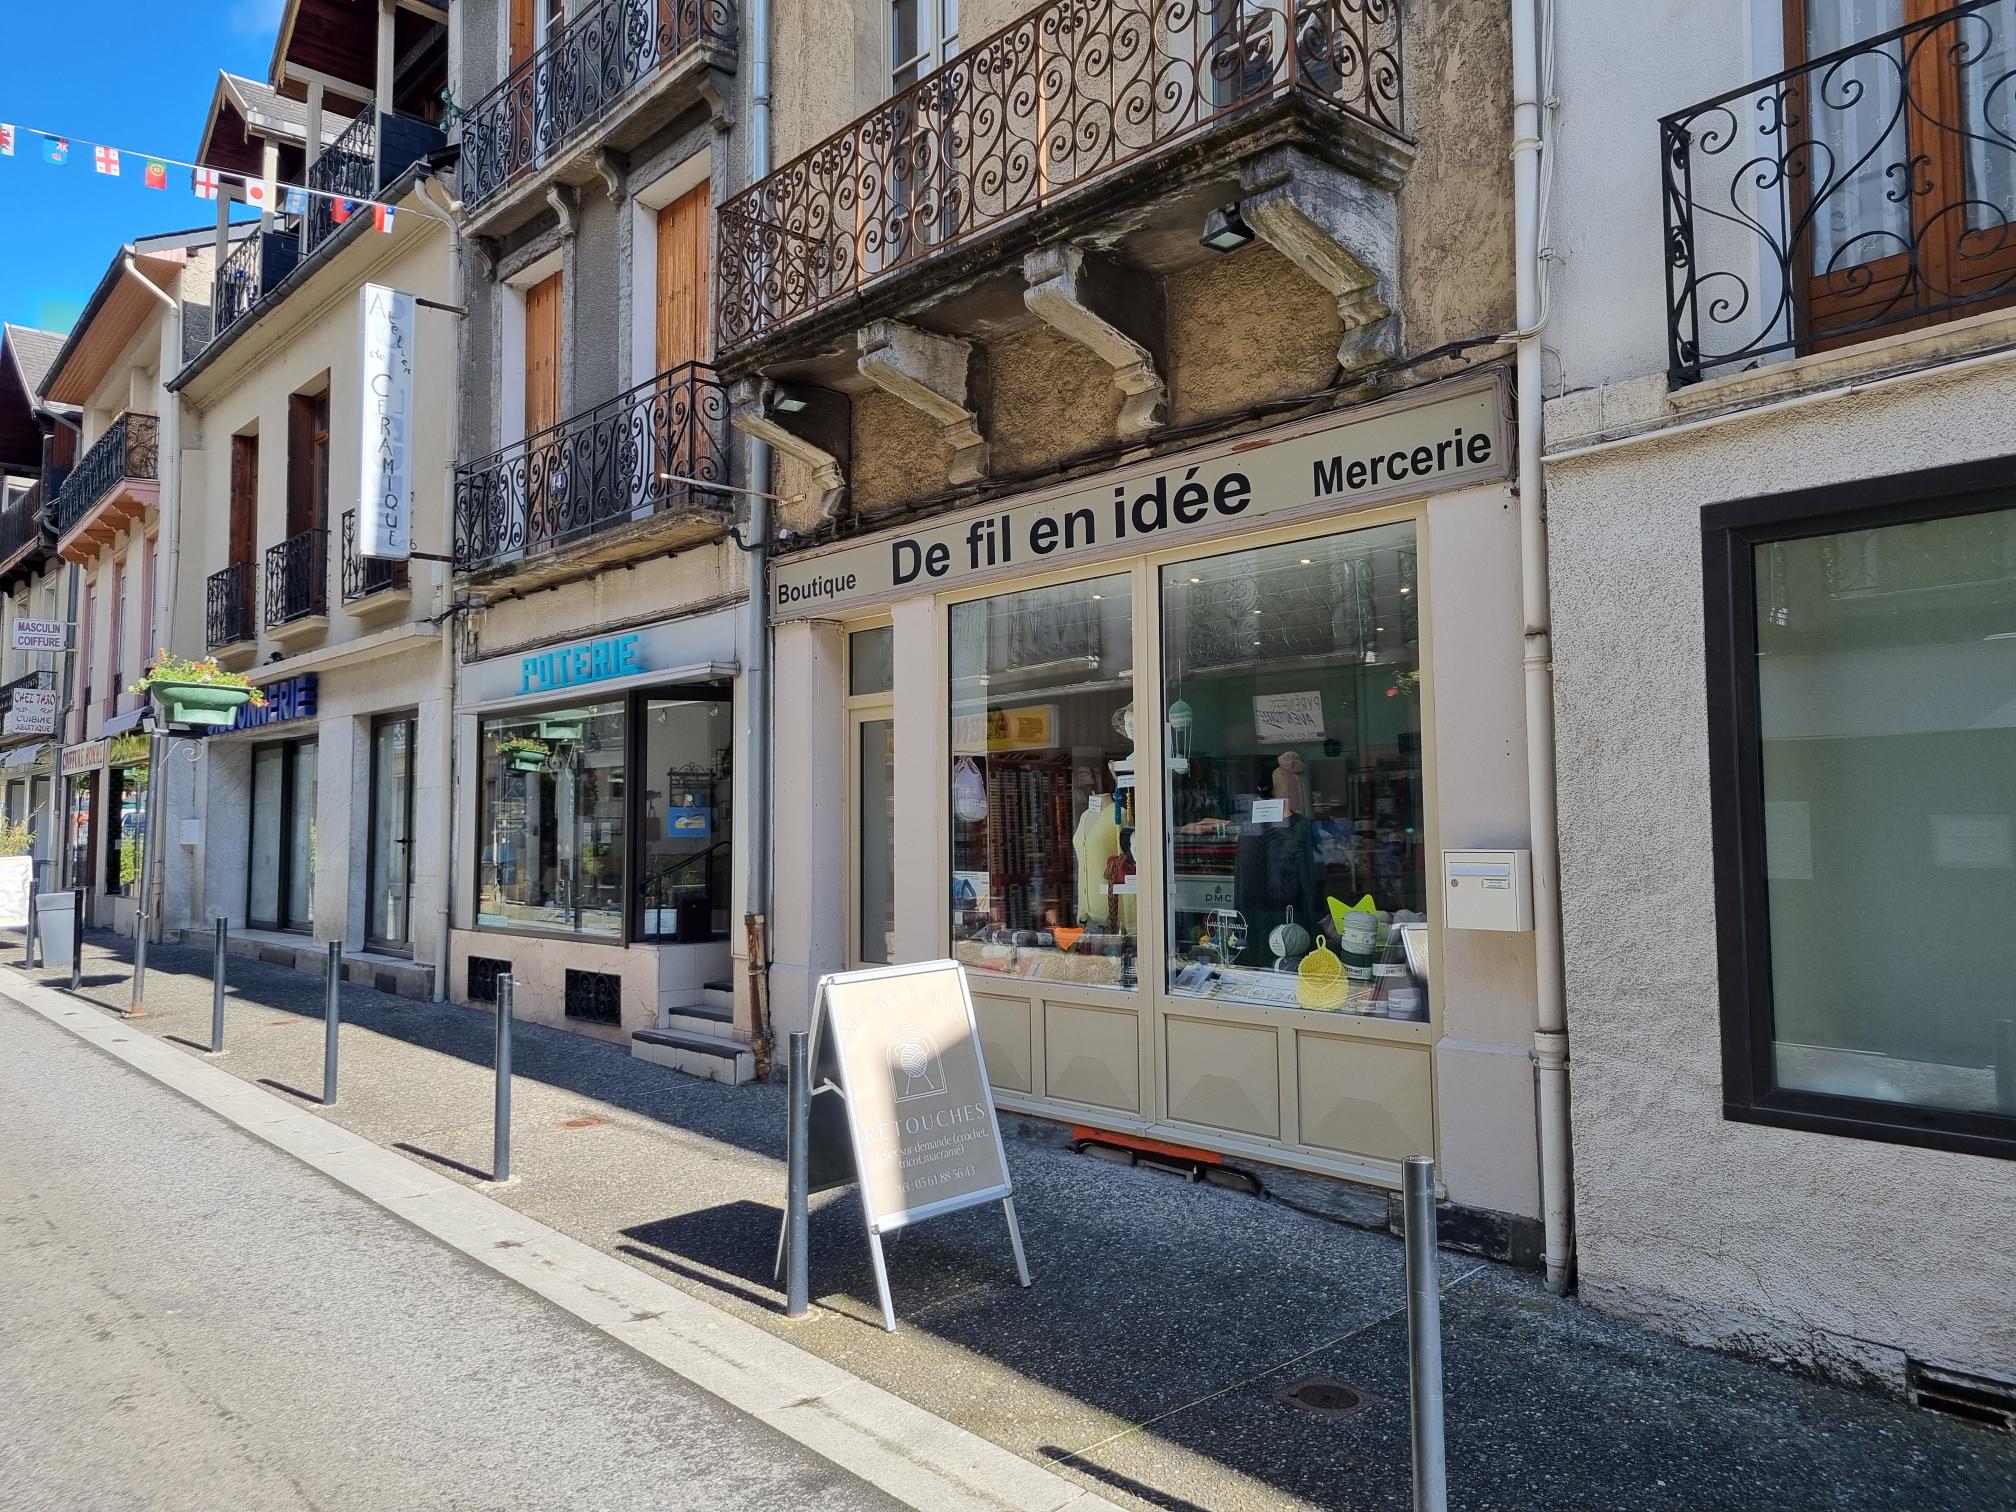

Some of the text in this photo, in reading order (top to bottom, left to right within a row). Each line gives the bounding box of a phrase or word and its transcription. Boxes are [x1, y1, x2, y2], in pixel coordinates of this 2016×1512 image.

[778, 428, 1492, 605] Boutique De fil en idée Mercerie
[18, 621, 61, 633] MASCULIN
[18, 635, 61, 647] COIFFURE
[521, 634, 640, 692] POTERIE
[15, 691, 34, 704] CHEZ
[16, 714, 52, 724] CUISINE
[864, 1102, 985, 1144] RETOUCHES
[900, 1146, 913, 1156] sur
[914, 1134, 952, 1153] demande
